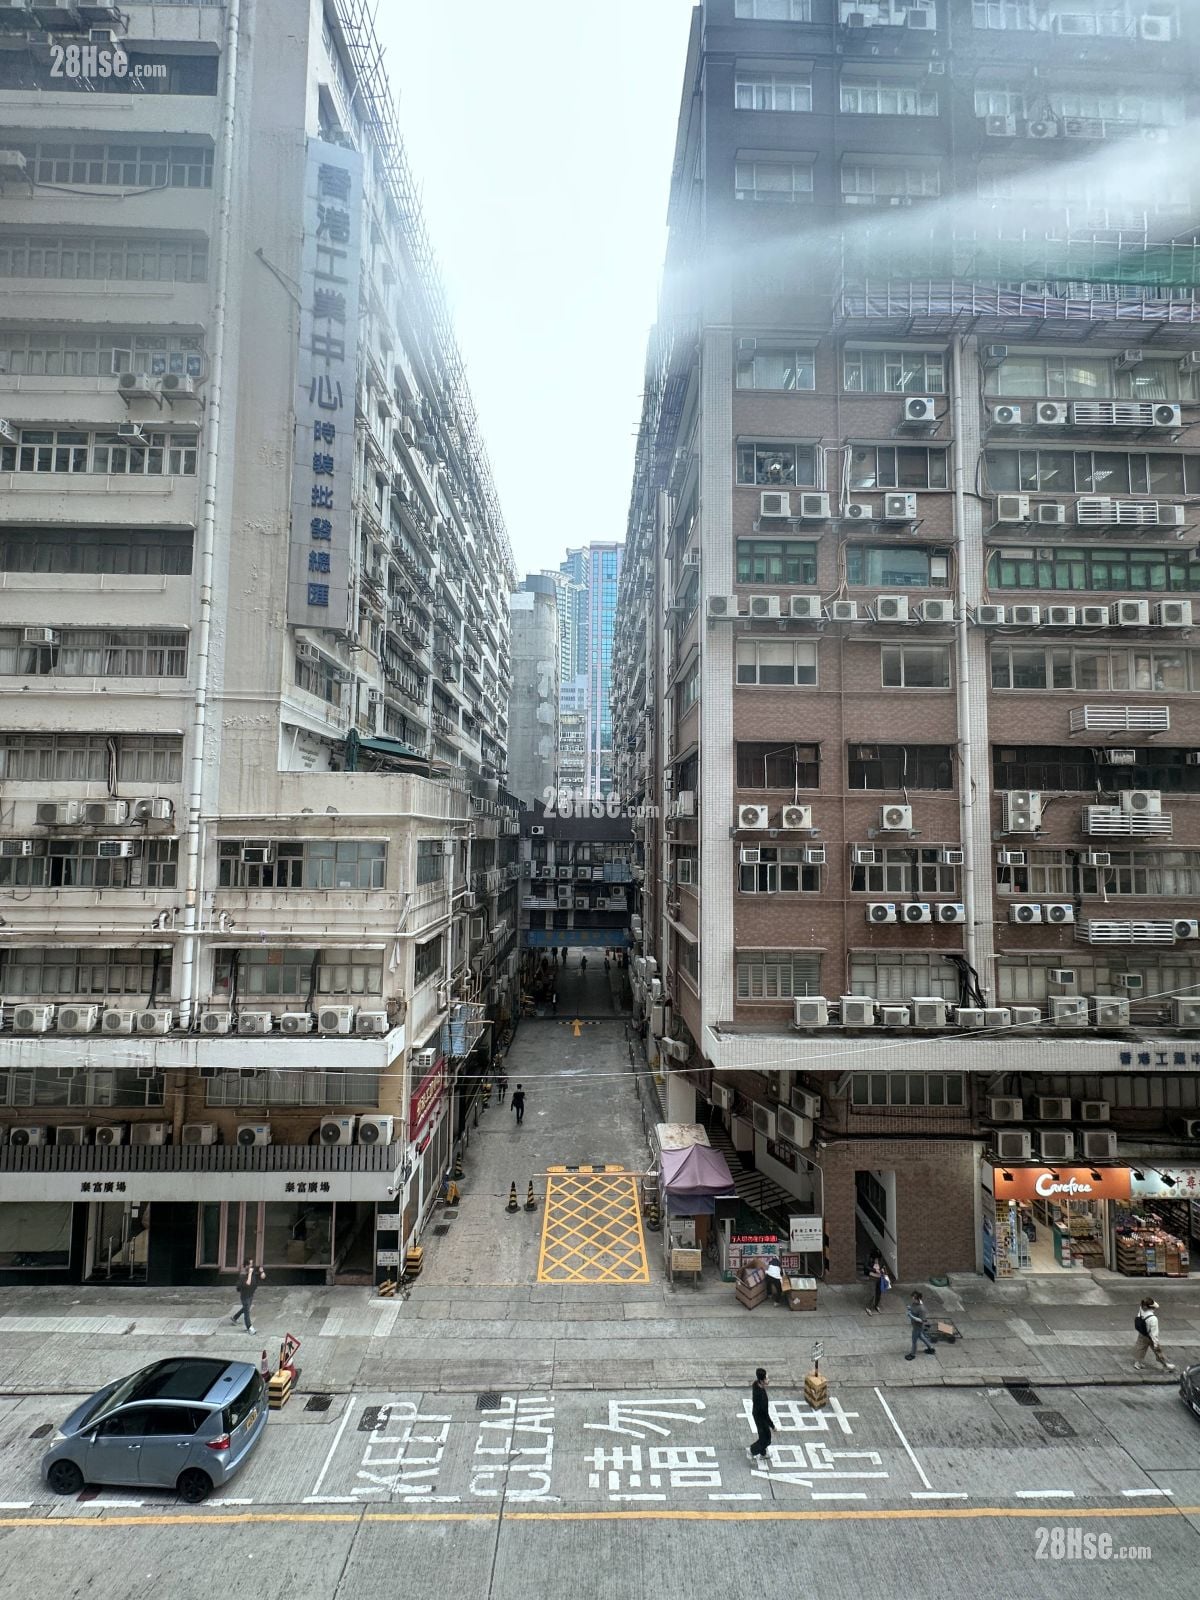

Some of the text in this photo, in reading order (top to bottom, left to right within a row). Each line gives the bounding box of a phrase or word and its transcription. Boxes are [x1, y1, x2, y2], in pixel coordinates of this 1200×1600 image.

[308, 162, 352, 410] 香港工業中心
[307, 419, 336, 607] 時裝批發總匯
[1035, 1173, 1092, 1197] Carefree
[350, 1401, 452, 1496] KEEP
[469, 1395, 557, 1497] CLEAR
[584, 1398, 720, 1489] 請勿
[736, 1396, 890, 1488] 停車
